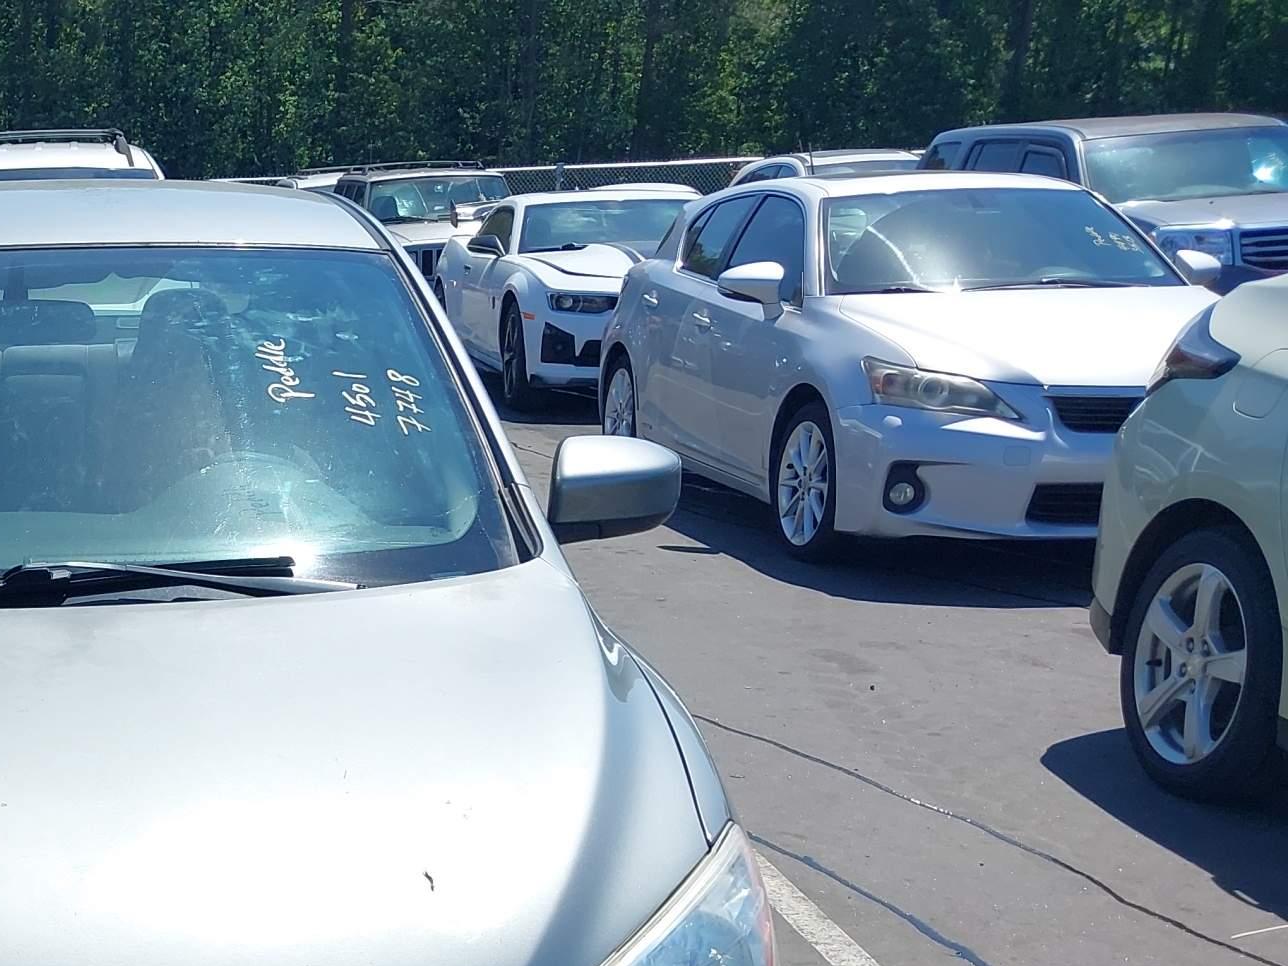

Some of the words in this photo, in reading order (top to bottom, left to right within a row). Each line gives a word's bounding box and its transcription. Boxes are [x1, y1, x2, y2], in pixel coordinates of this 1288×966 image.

[255, 335, 315, 403] Peddle
[332, 370, 382, 427] 4501
[386, 368, 432, 435] 7748
